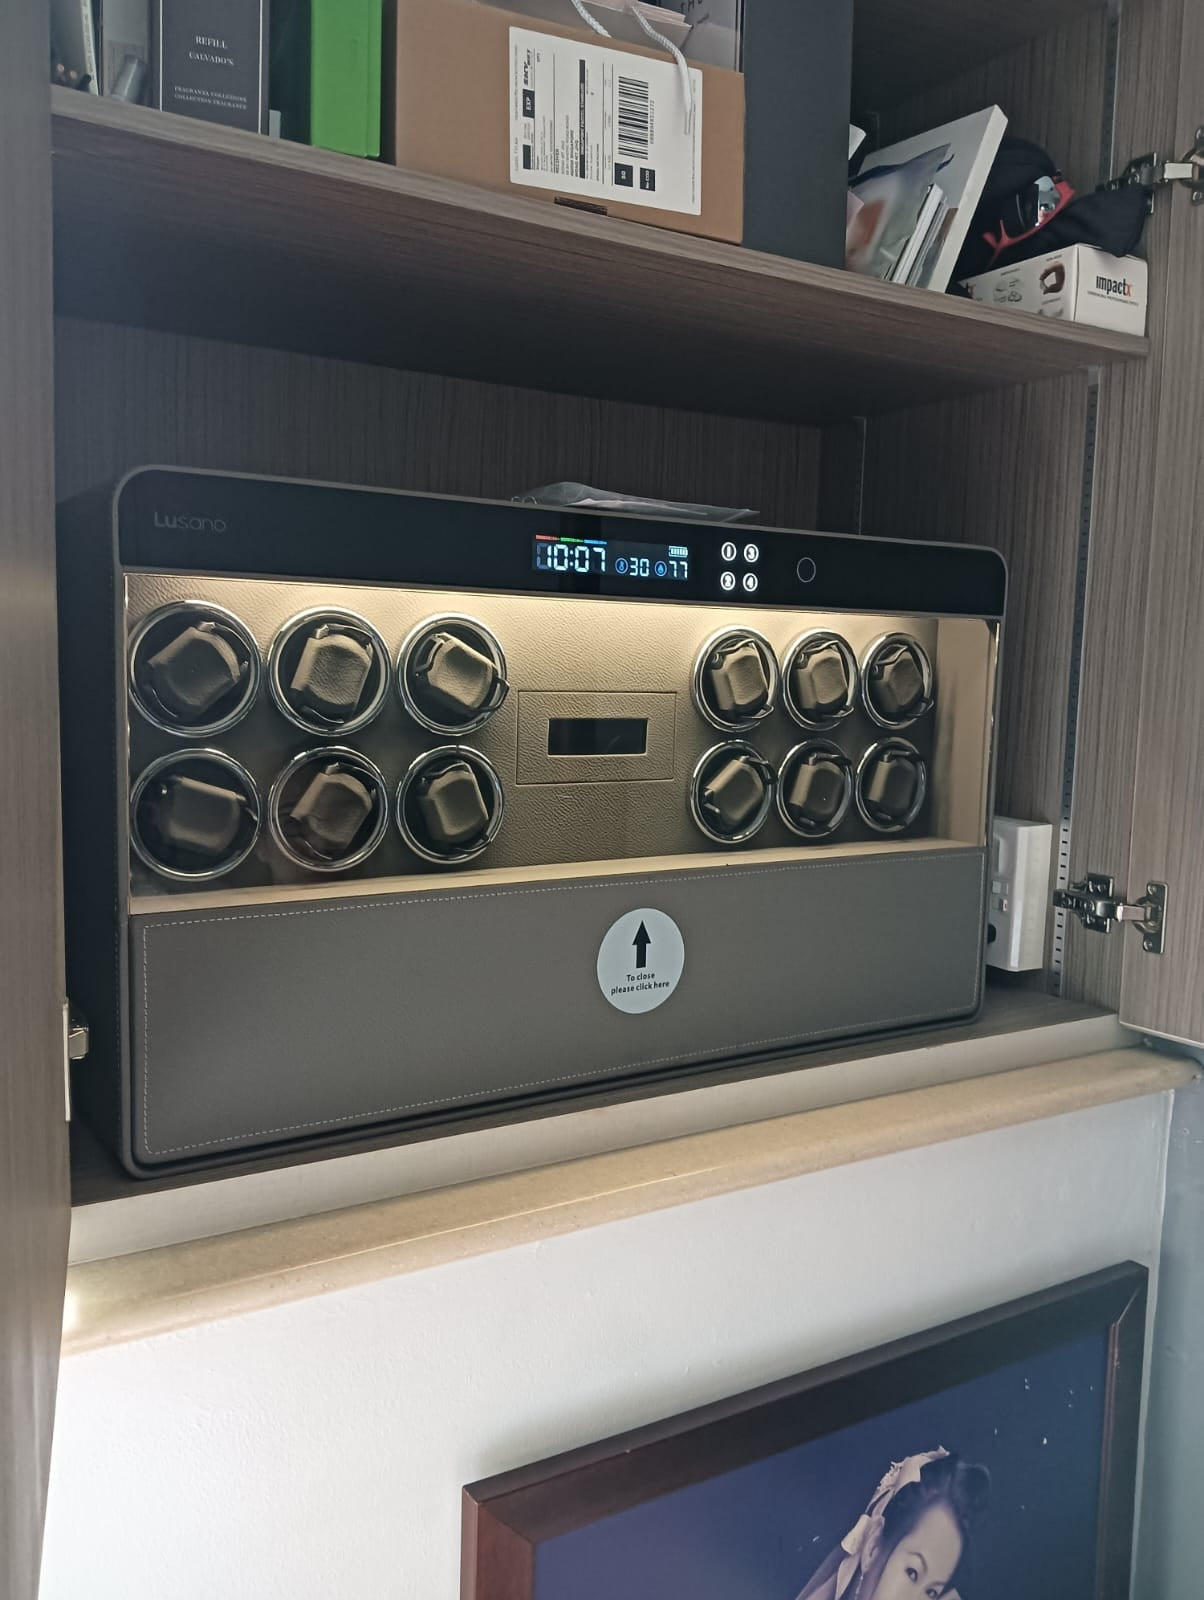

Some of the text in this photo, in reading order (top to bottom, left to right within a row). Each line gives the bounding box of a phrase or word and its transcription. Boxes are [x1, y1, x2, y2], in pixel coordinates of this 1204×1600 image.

[195, 36, 228, 49] REFILL
[546, 543, 606, 573] 10:07
[630, 557, 650, 577] 30
[669, 560, 688, 578] 77
[626, 971, 656, 982] To close
[610, 981, 670, 996] please click here
